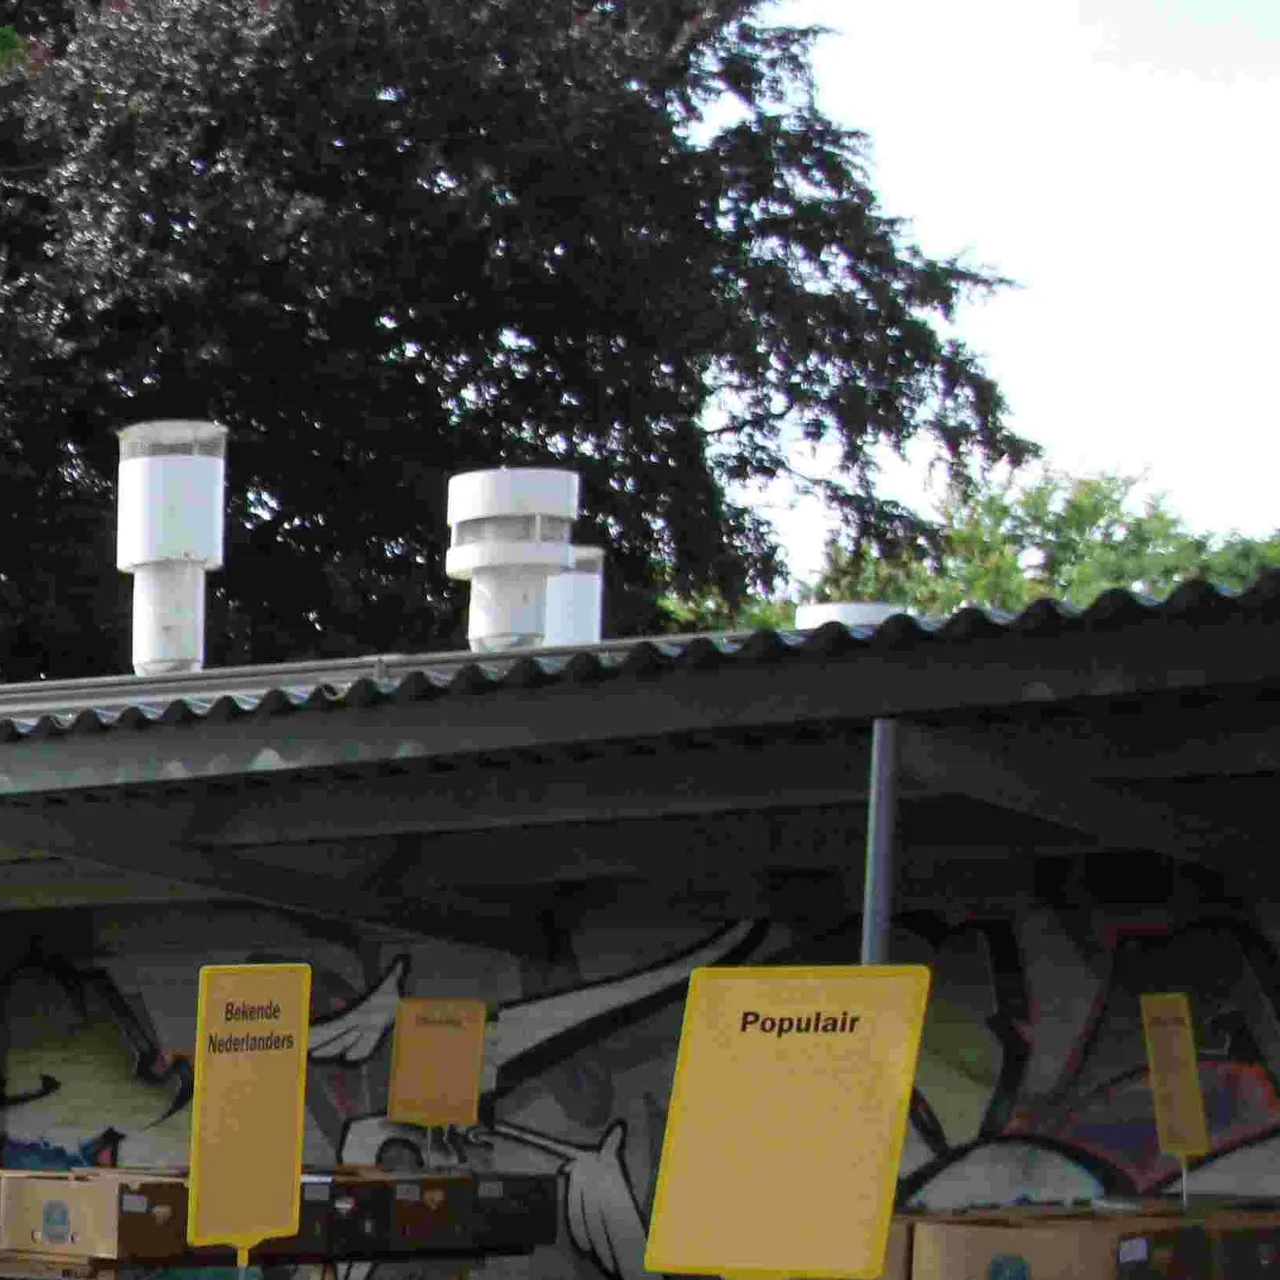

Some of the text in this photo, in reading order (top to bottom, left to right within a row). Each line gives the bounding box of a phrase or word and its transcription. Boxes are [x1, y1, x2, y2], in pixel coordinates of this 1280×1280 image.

[224, 999, 282, 1022] Bekende
[739, 1009, 862, 1038] Populair
[207, 1030, 295, 1055] Nederlanders
